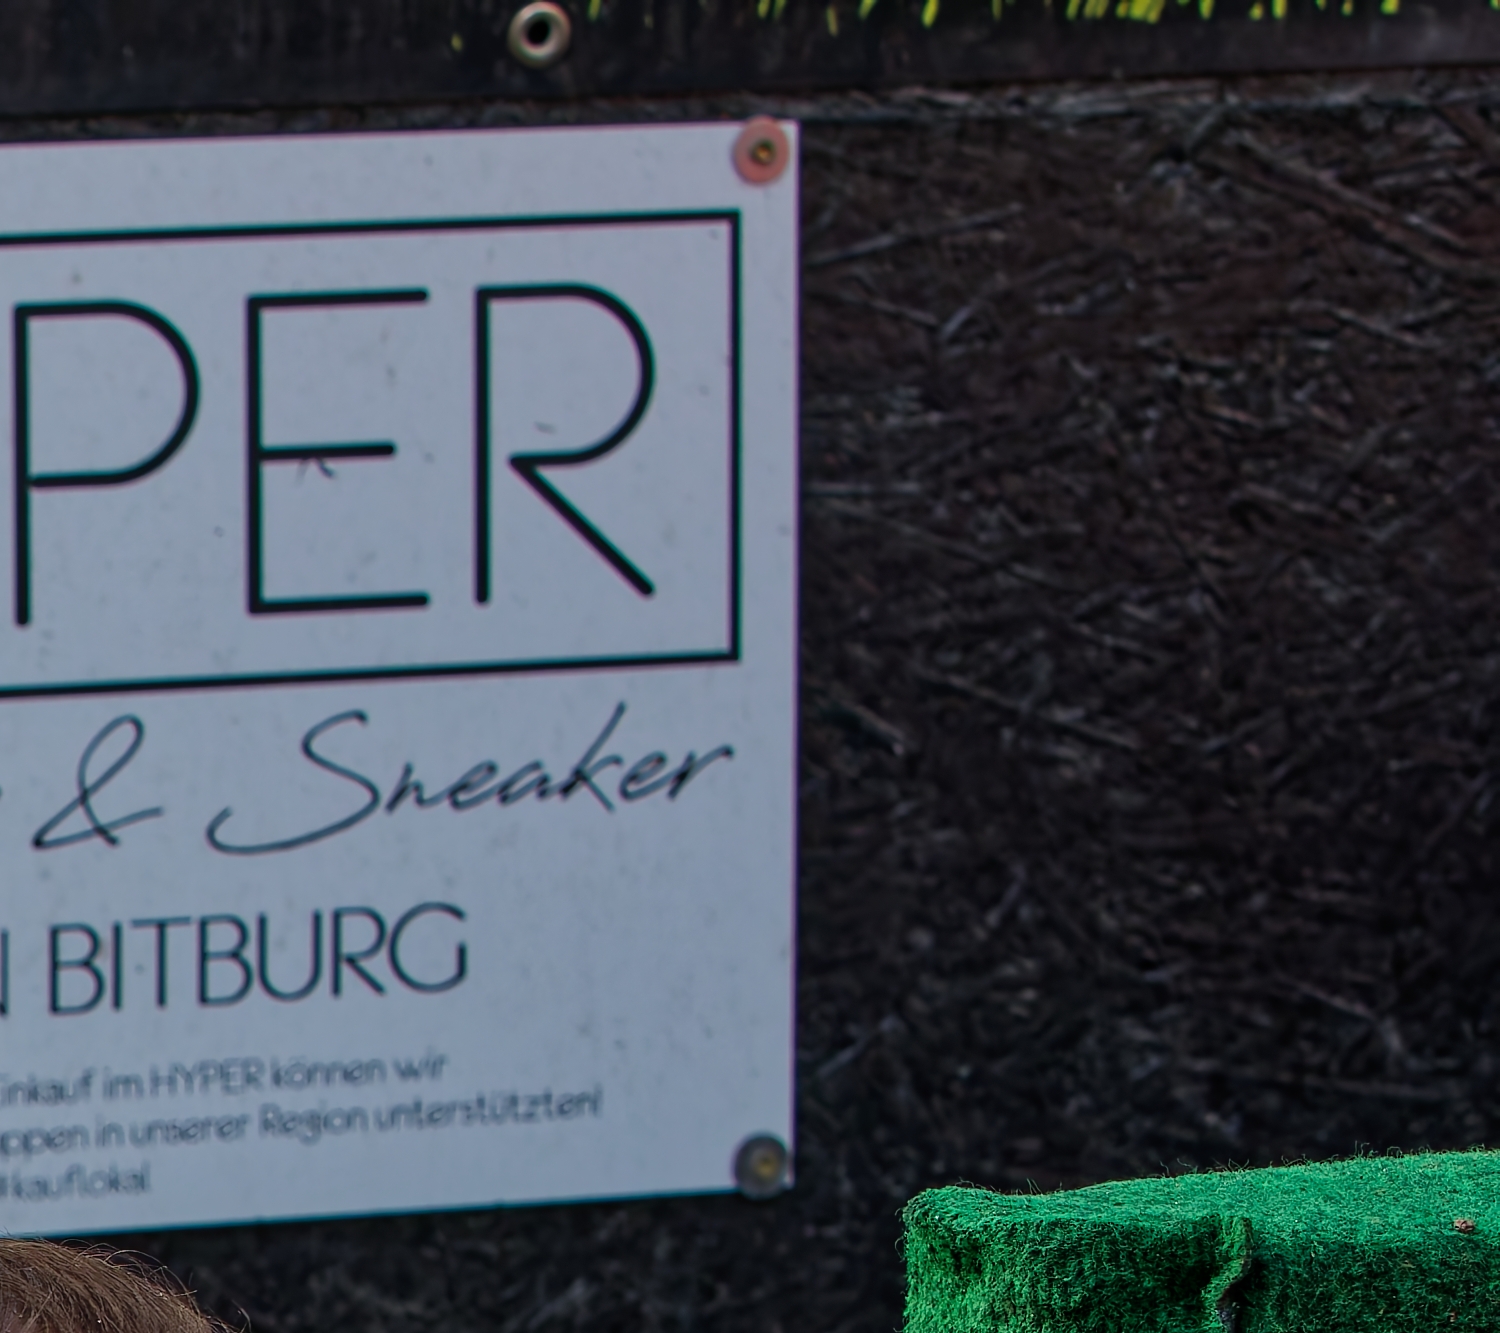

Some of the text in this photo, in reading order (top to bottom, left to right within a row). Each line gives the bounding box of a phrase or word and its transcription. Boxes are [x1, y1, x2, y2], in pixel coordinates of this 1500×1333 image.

[31, 714, 164, 849] &
[206, 701, 734, 855] Sneaker
[48, 902, 468, 1016] BITBURG
[102, 1064, 145, 1099] im
[149, 1056, 266, 1099] HYPER
[270, 1053, 387, 1093] können
[392, 1045, 447, 1084] wir
[94, 1113, 126, 1148] in
[128, 1112, 249, 1149] unserer
[258, 1101, 370, 1146] Region
